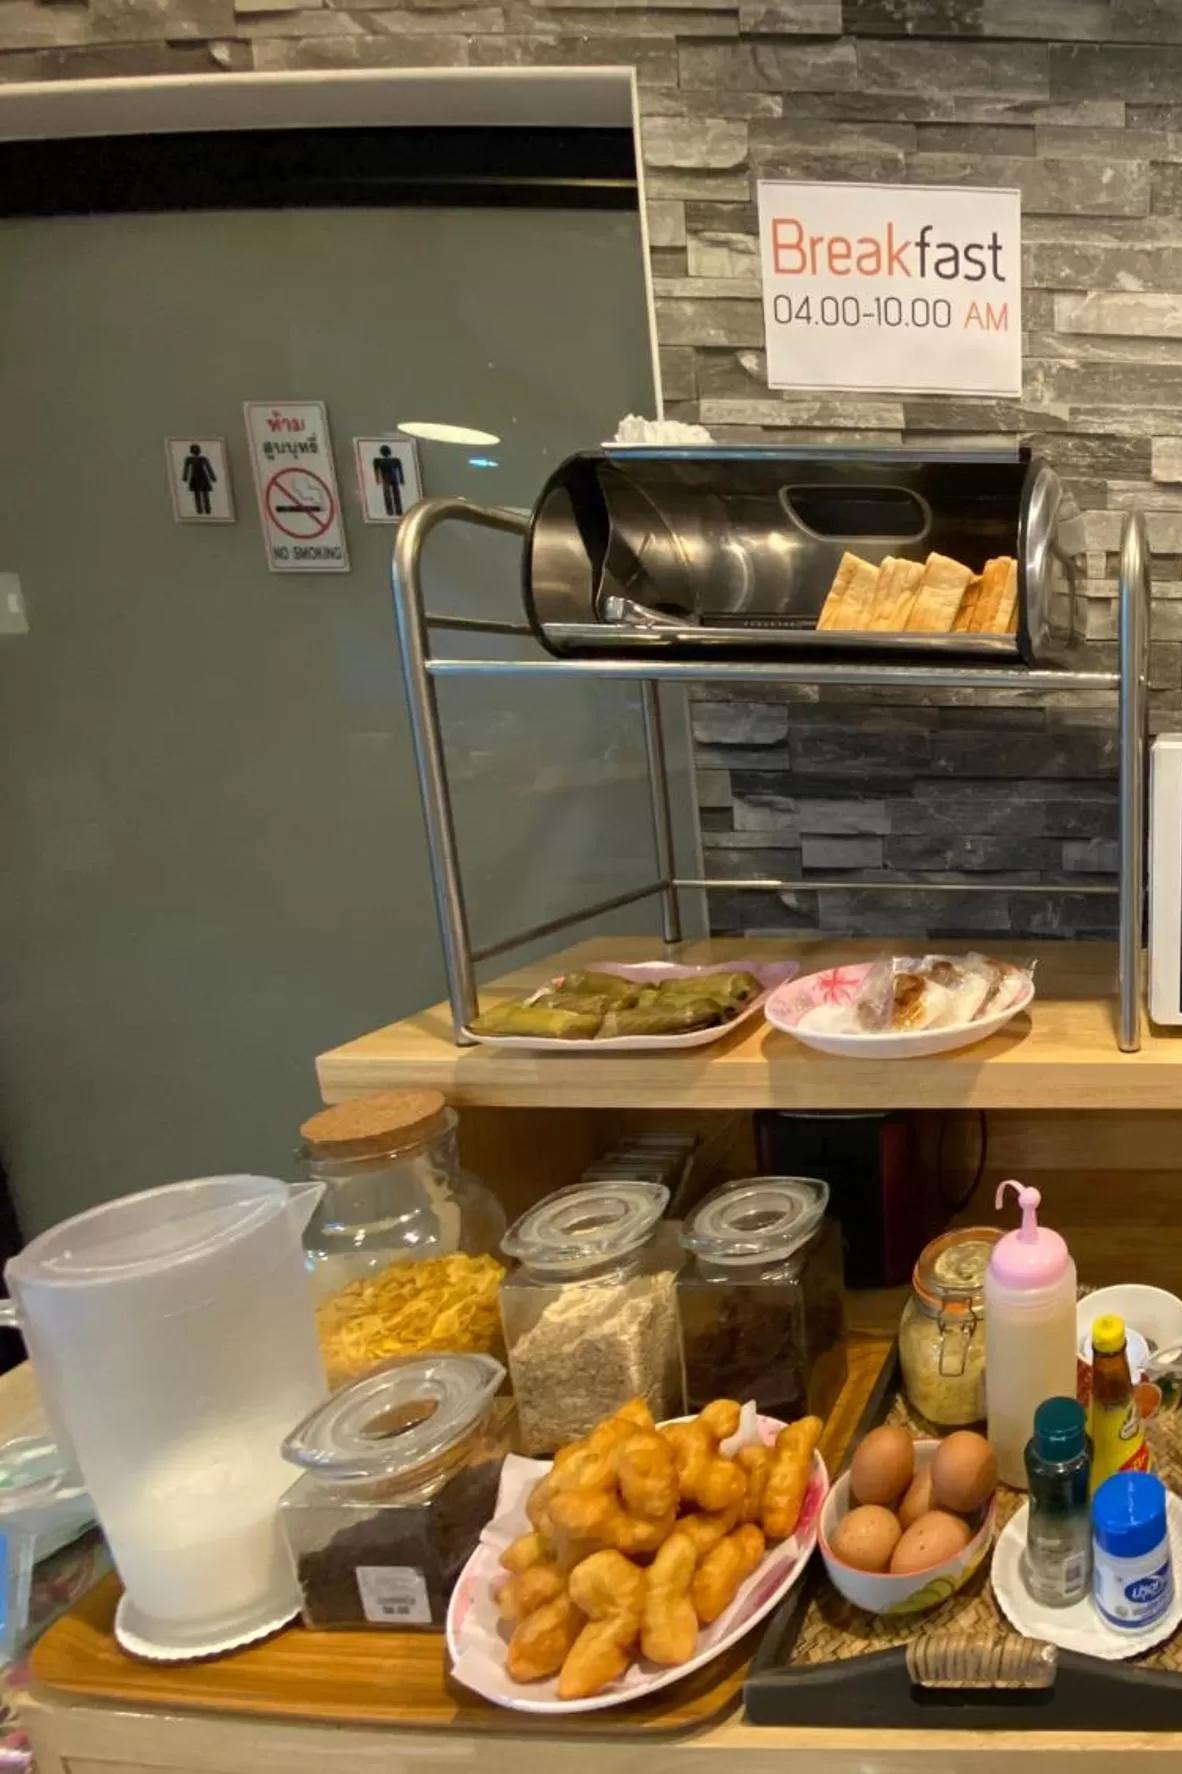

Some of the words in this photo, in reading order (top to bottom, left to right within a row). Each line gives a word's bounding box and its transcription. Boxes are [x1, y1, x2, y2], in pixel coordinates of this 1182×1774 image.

[771, 217, 1006, 283] Breakfast
[773, 294, 951, 329] 04.00-10.00
[963, 301, 1009, 332] AM
[273, 546, 290, 561] NO
[293, 546, 343, 561] SMOKING
